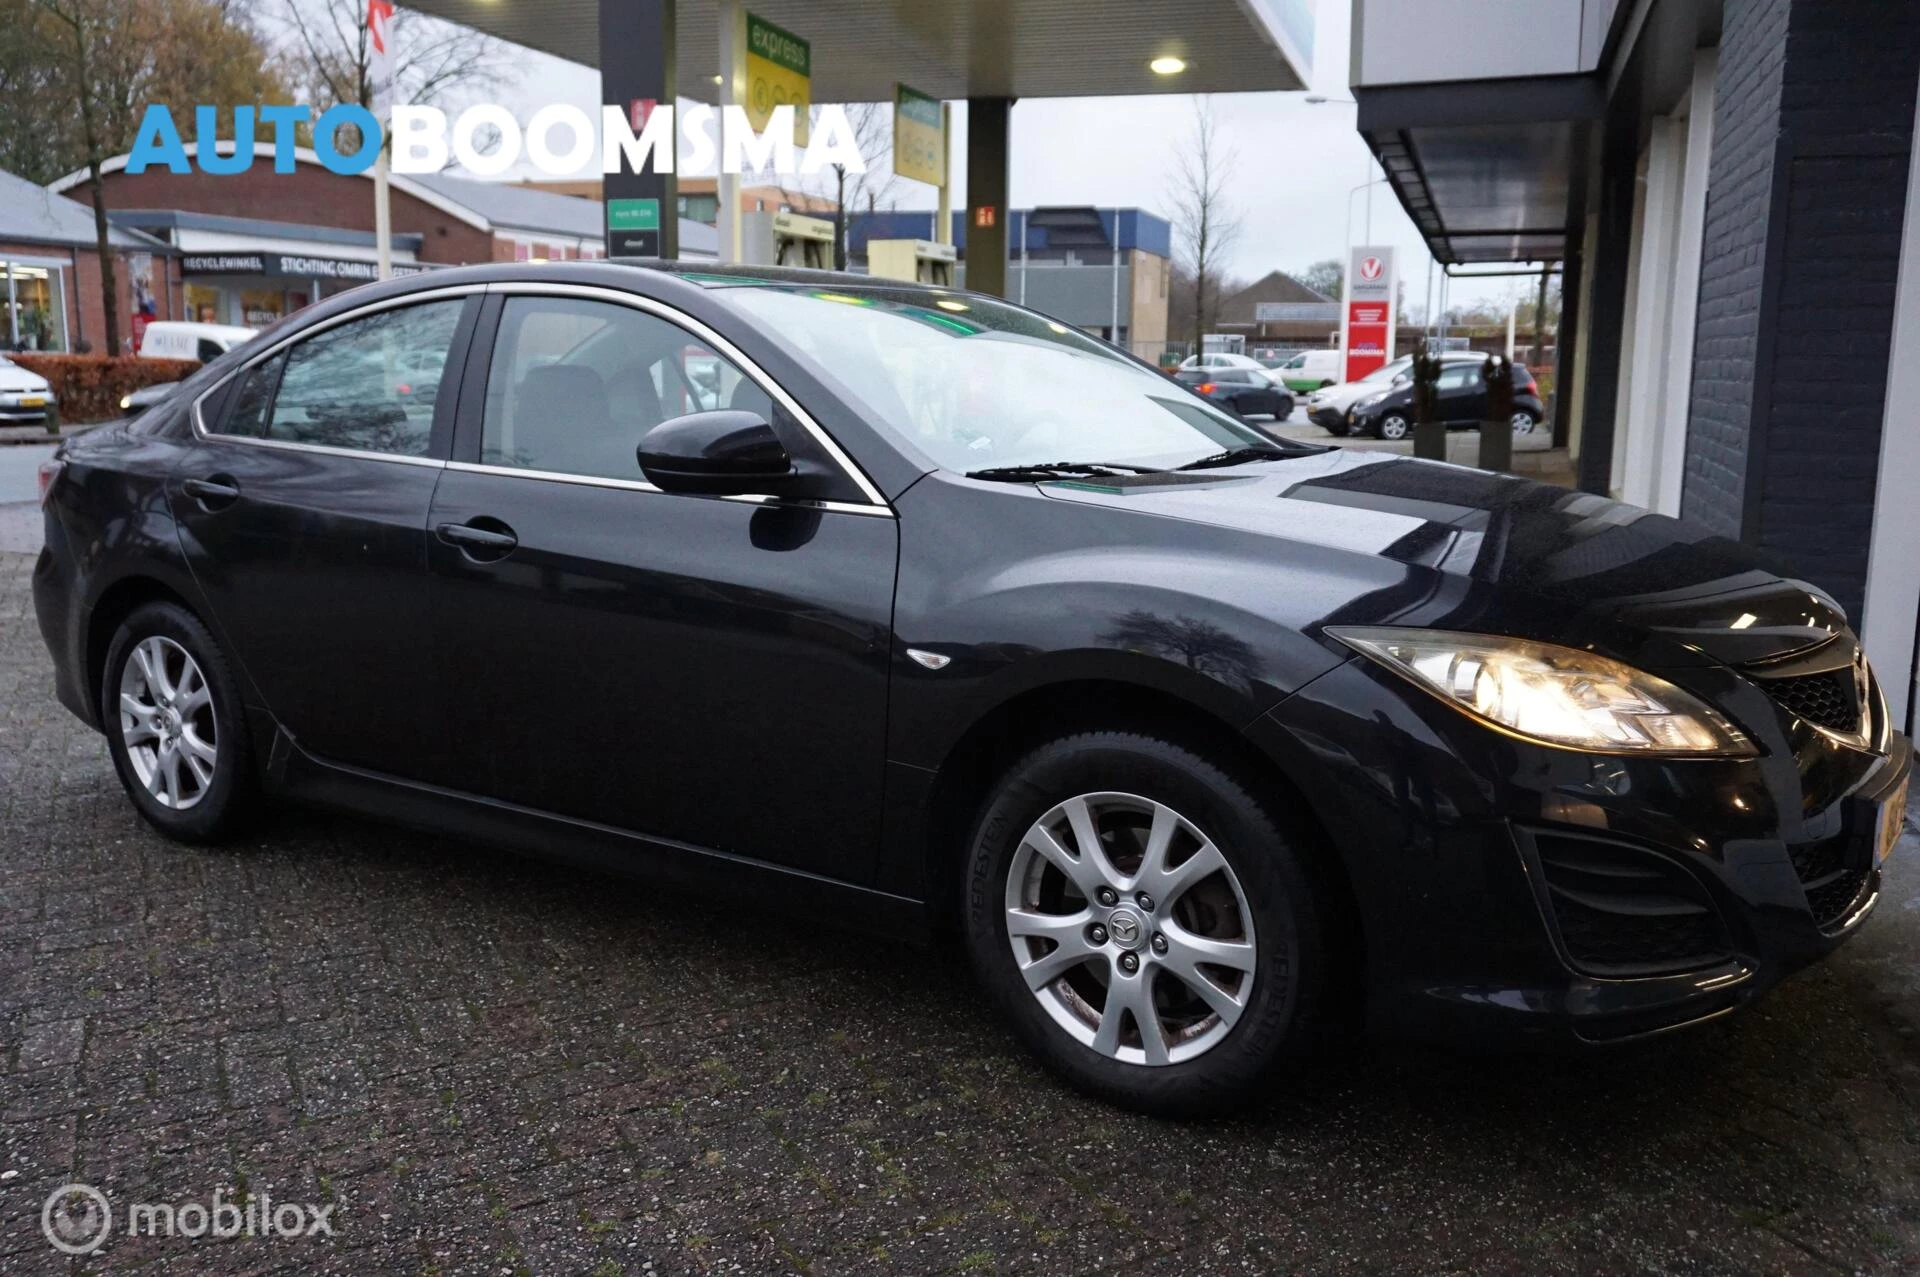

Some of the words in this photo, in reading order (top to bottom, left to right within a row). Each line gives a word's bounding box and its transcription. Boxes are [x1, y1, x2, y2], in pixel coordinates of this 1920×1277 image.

[753, 25, 806, 67] express
[183, 257, 263, 270] RECYCLEWINKEL
[281, 256, 336, 276] STICHTING
